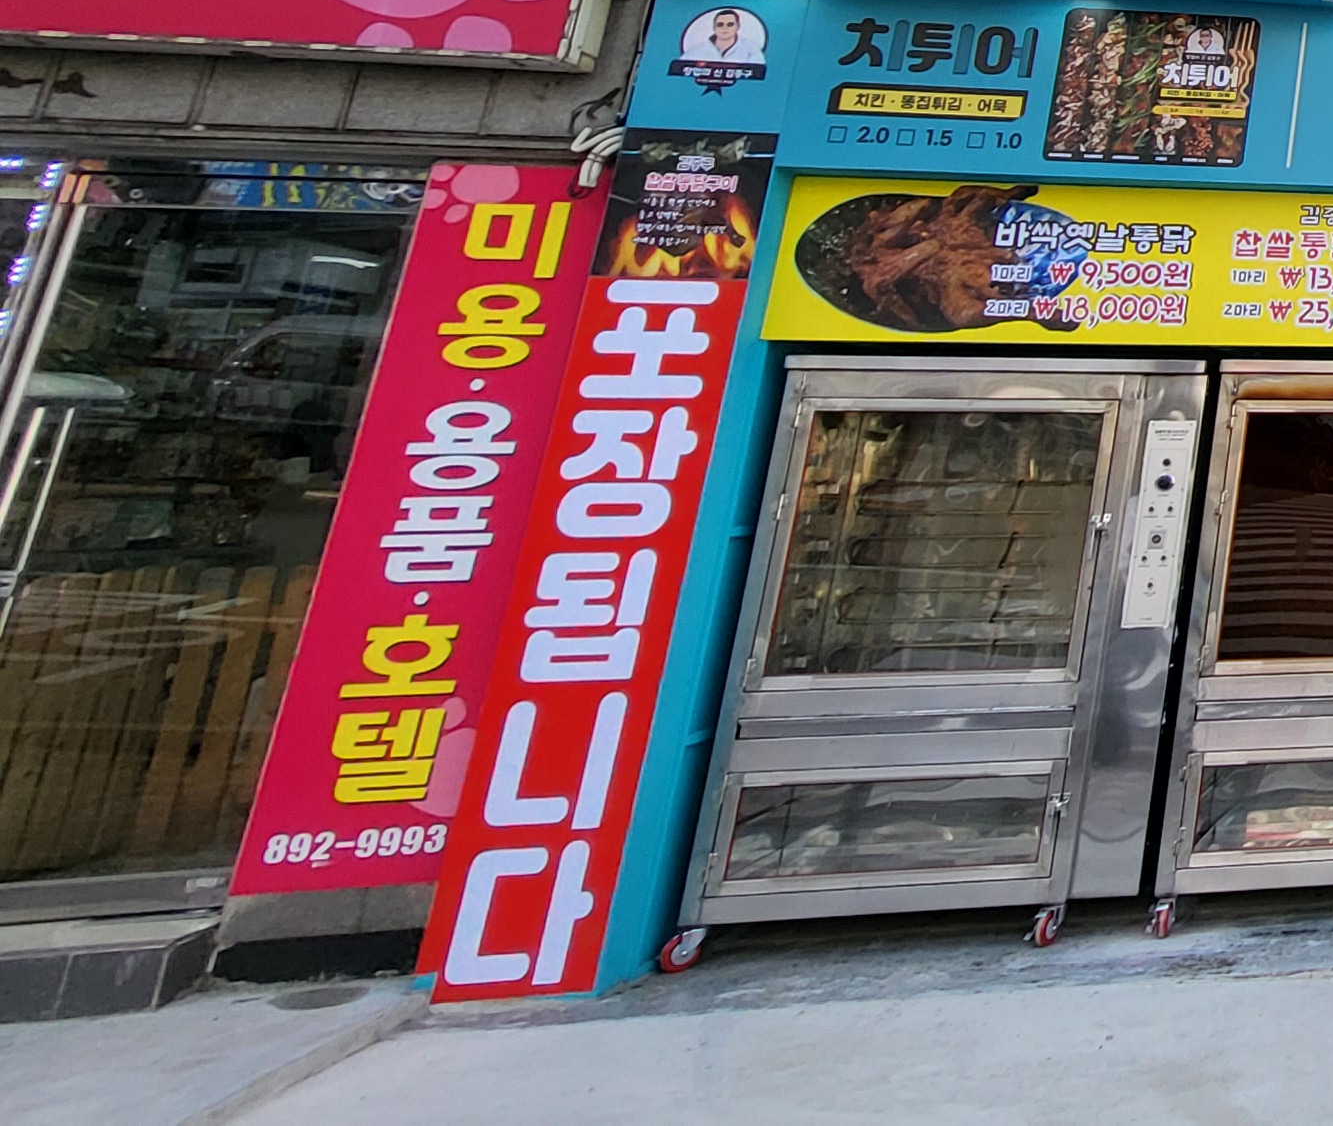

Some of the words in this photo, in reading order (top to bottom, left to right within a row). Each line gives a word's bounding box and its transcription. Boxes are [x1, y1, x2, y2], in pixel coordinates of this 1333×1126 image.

[838, 17, 1039, 78] 치튀어
[1162, 62, 1239, 88] 치튀어
[853, 92, 885, 111] 치킨
[900, 95, 962, 114] 똥집튀김
[857, 126, 889, 145] 2.0
[924, 128, 953, 147] 1.5
[994, 132, 1023, 150] 1.0
[992, 219, 1197, 255] 바싹옛날통닭
[443, 279, 720, 988] 포장됩니다
[263, 823, 446, 867] 892-9993
